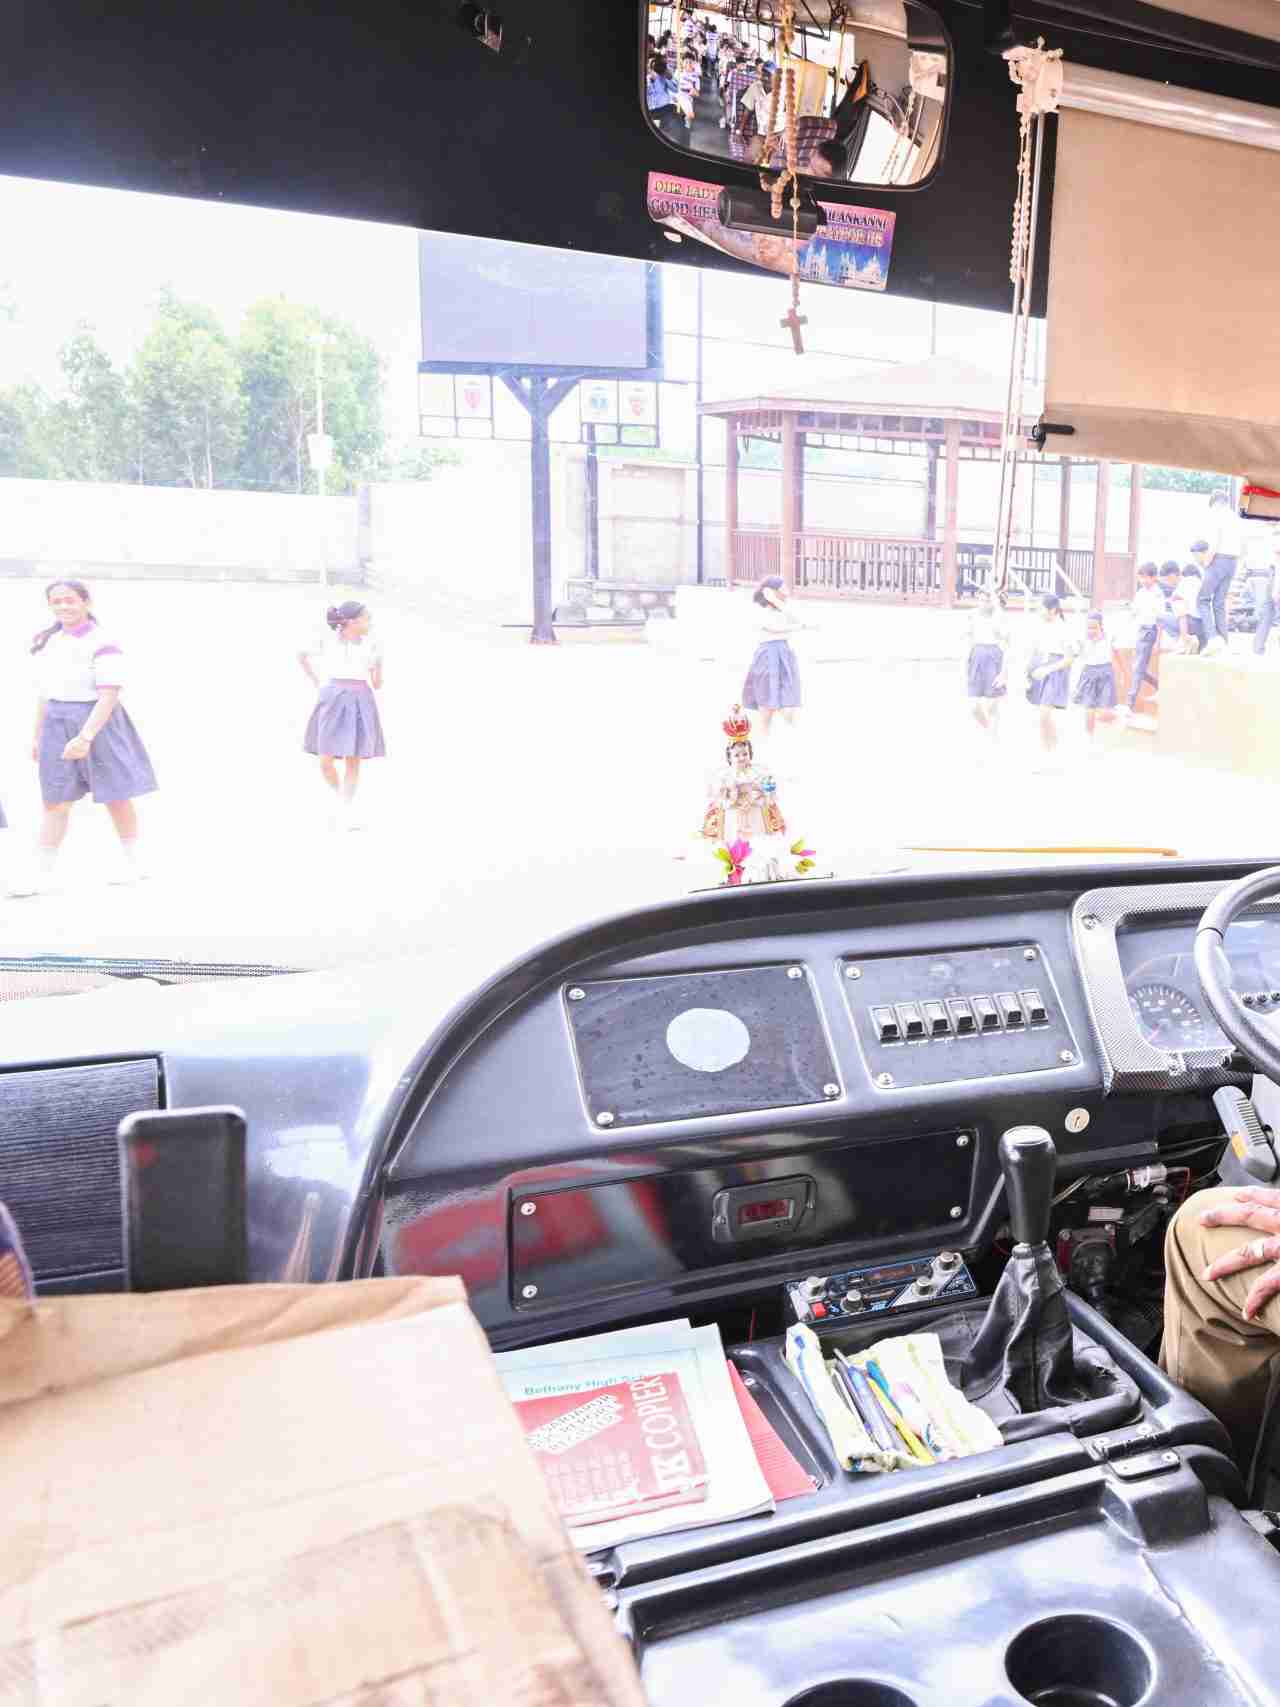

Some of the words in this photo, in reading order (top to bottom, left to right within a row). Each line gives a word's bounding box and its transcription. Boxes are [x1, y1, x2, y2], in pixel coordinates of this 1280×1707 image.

[656, 181, 682, 194] OUR
[651, 199, 689, 216] GOOD
[523, 1381, 582, 1395] Bethany
[629, 1375, 684, 1450] COPIER
